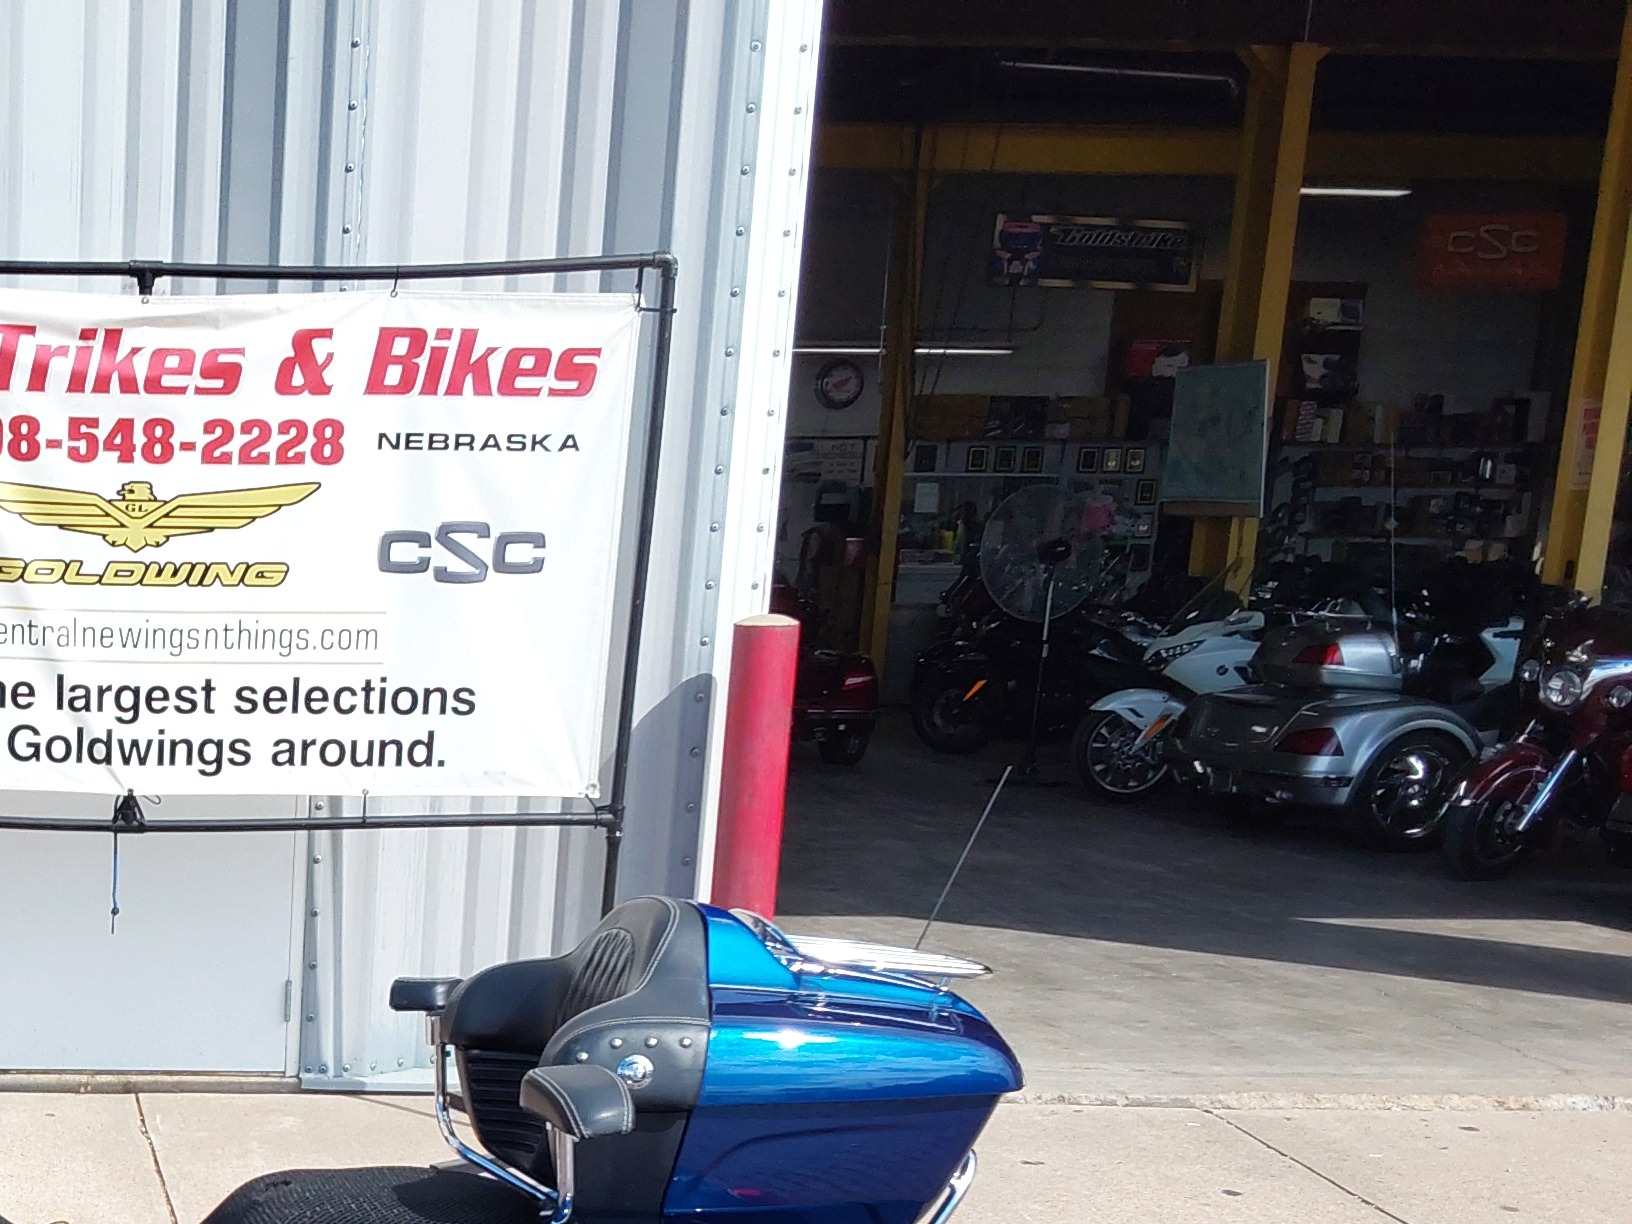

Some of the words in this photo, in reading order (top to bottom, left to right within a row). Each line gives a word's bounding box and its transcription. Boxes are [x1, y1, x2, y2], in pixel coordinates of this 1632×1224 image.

[274, 327, 335, 396] &
[363, 326, 603, 397] Bikes
[376, 432, 581, 453] NEBRASKA
[123, 503, 149, 513] GL
[55, 673, 216, 725] largest
[233, 676, 477, 717] selections
[6, 723, 252, 777] Goldwings
[270, 730, 446, 768] around.
